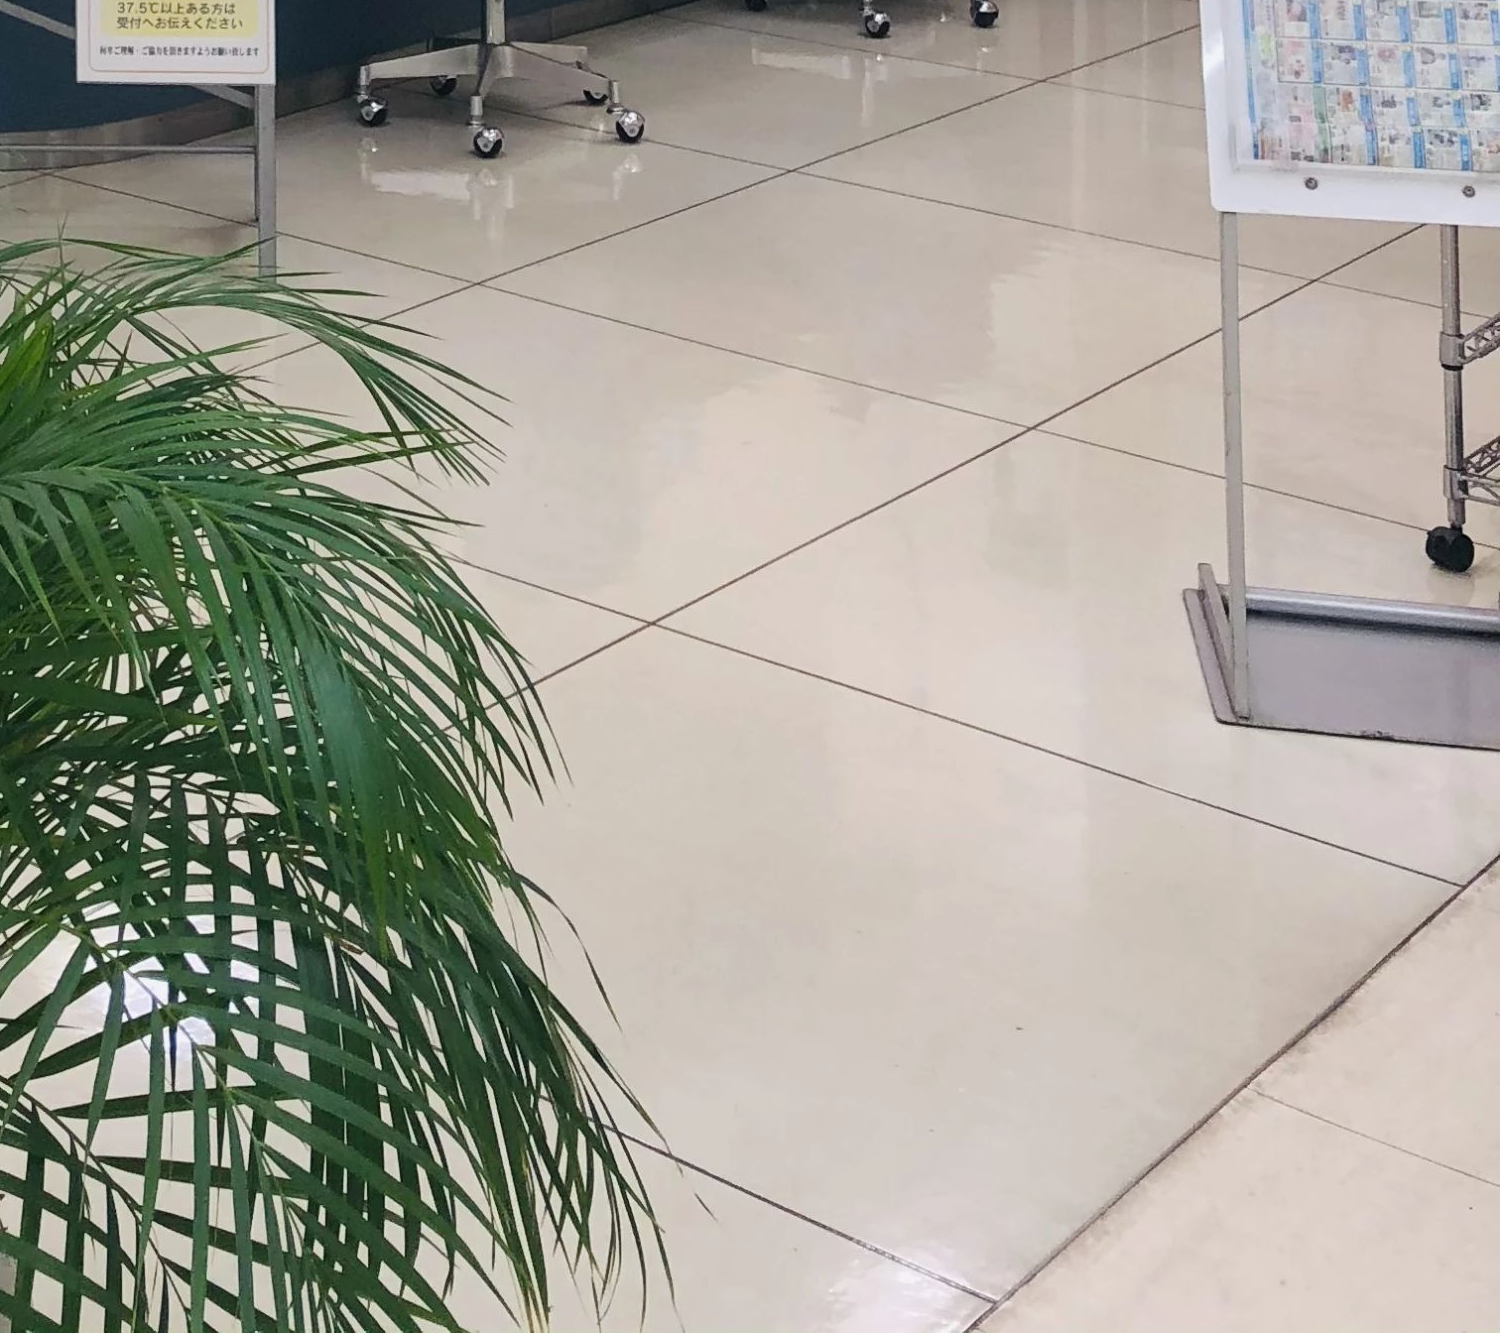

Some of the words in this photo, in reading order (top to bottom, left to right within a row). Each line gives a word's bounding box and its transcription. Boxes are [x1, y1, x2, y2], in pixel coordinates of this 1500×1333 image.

[116, 1, 237, 15] 37.5℃以上ある方は
[116, 16, 244, 30] 受付へお伝えください
